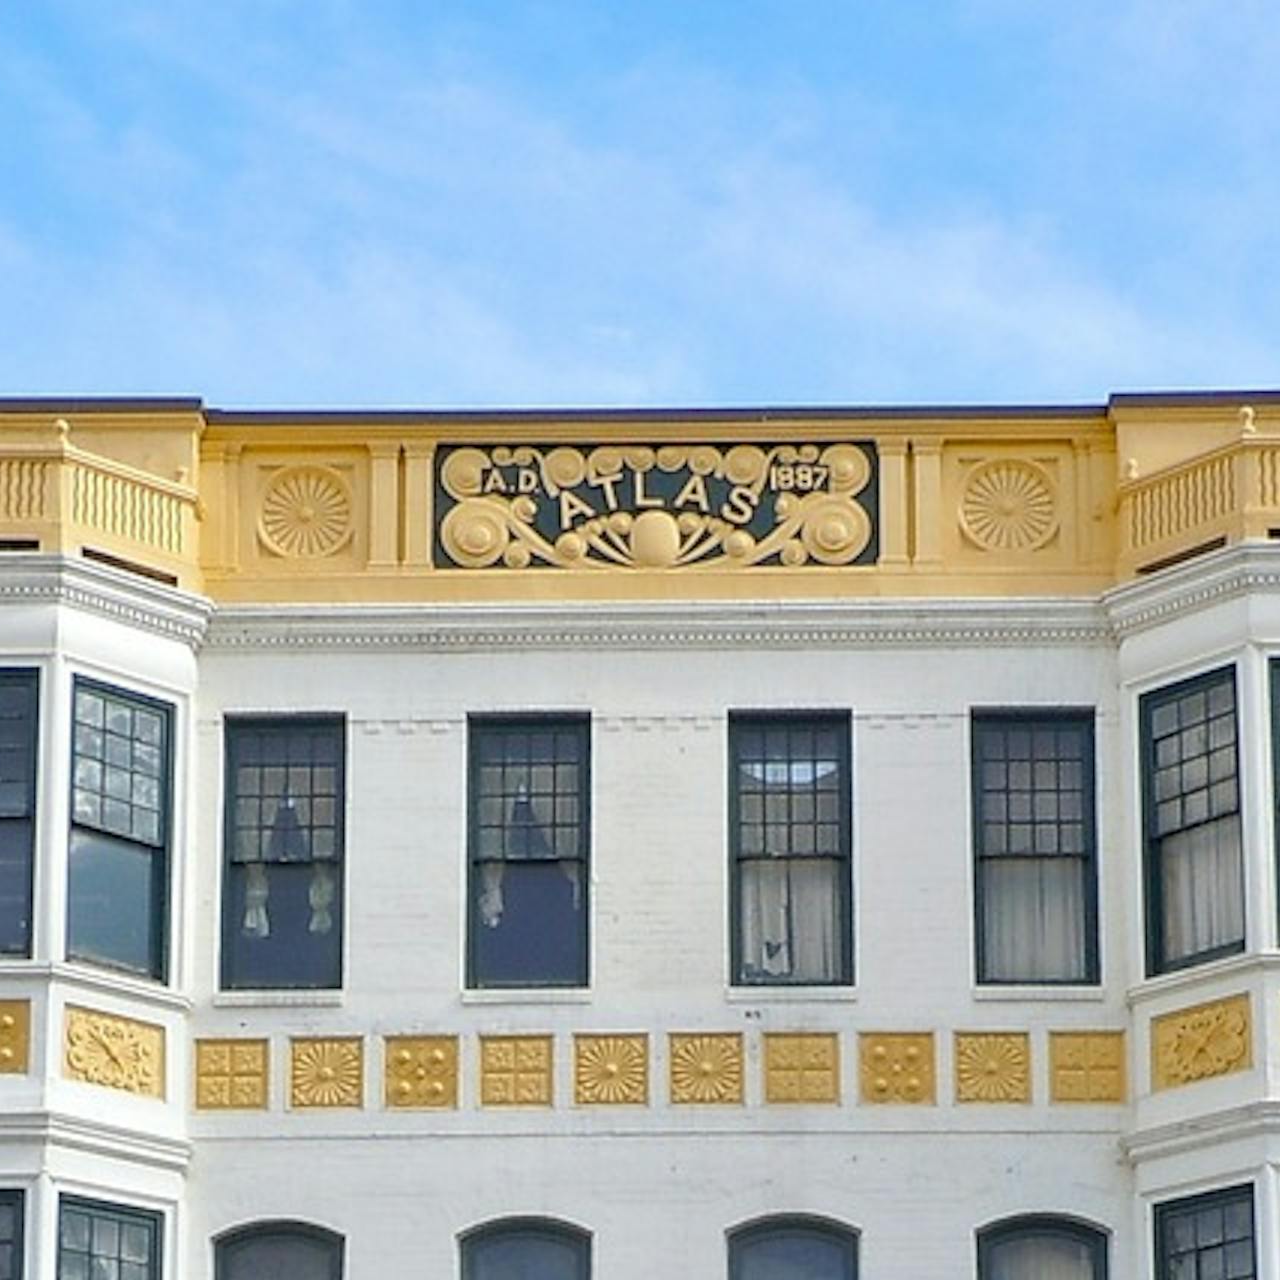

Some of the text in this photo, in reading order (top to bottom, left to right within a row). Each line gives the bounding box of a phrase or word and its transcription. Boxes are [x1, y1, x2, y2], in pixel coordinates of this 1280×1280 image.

[483, 468, 540, 494] A.D.
[770, 464, 828, 491] 1887
[559, 471, 760, 529] ATLAS
